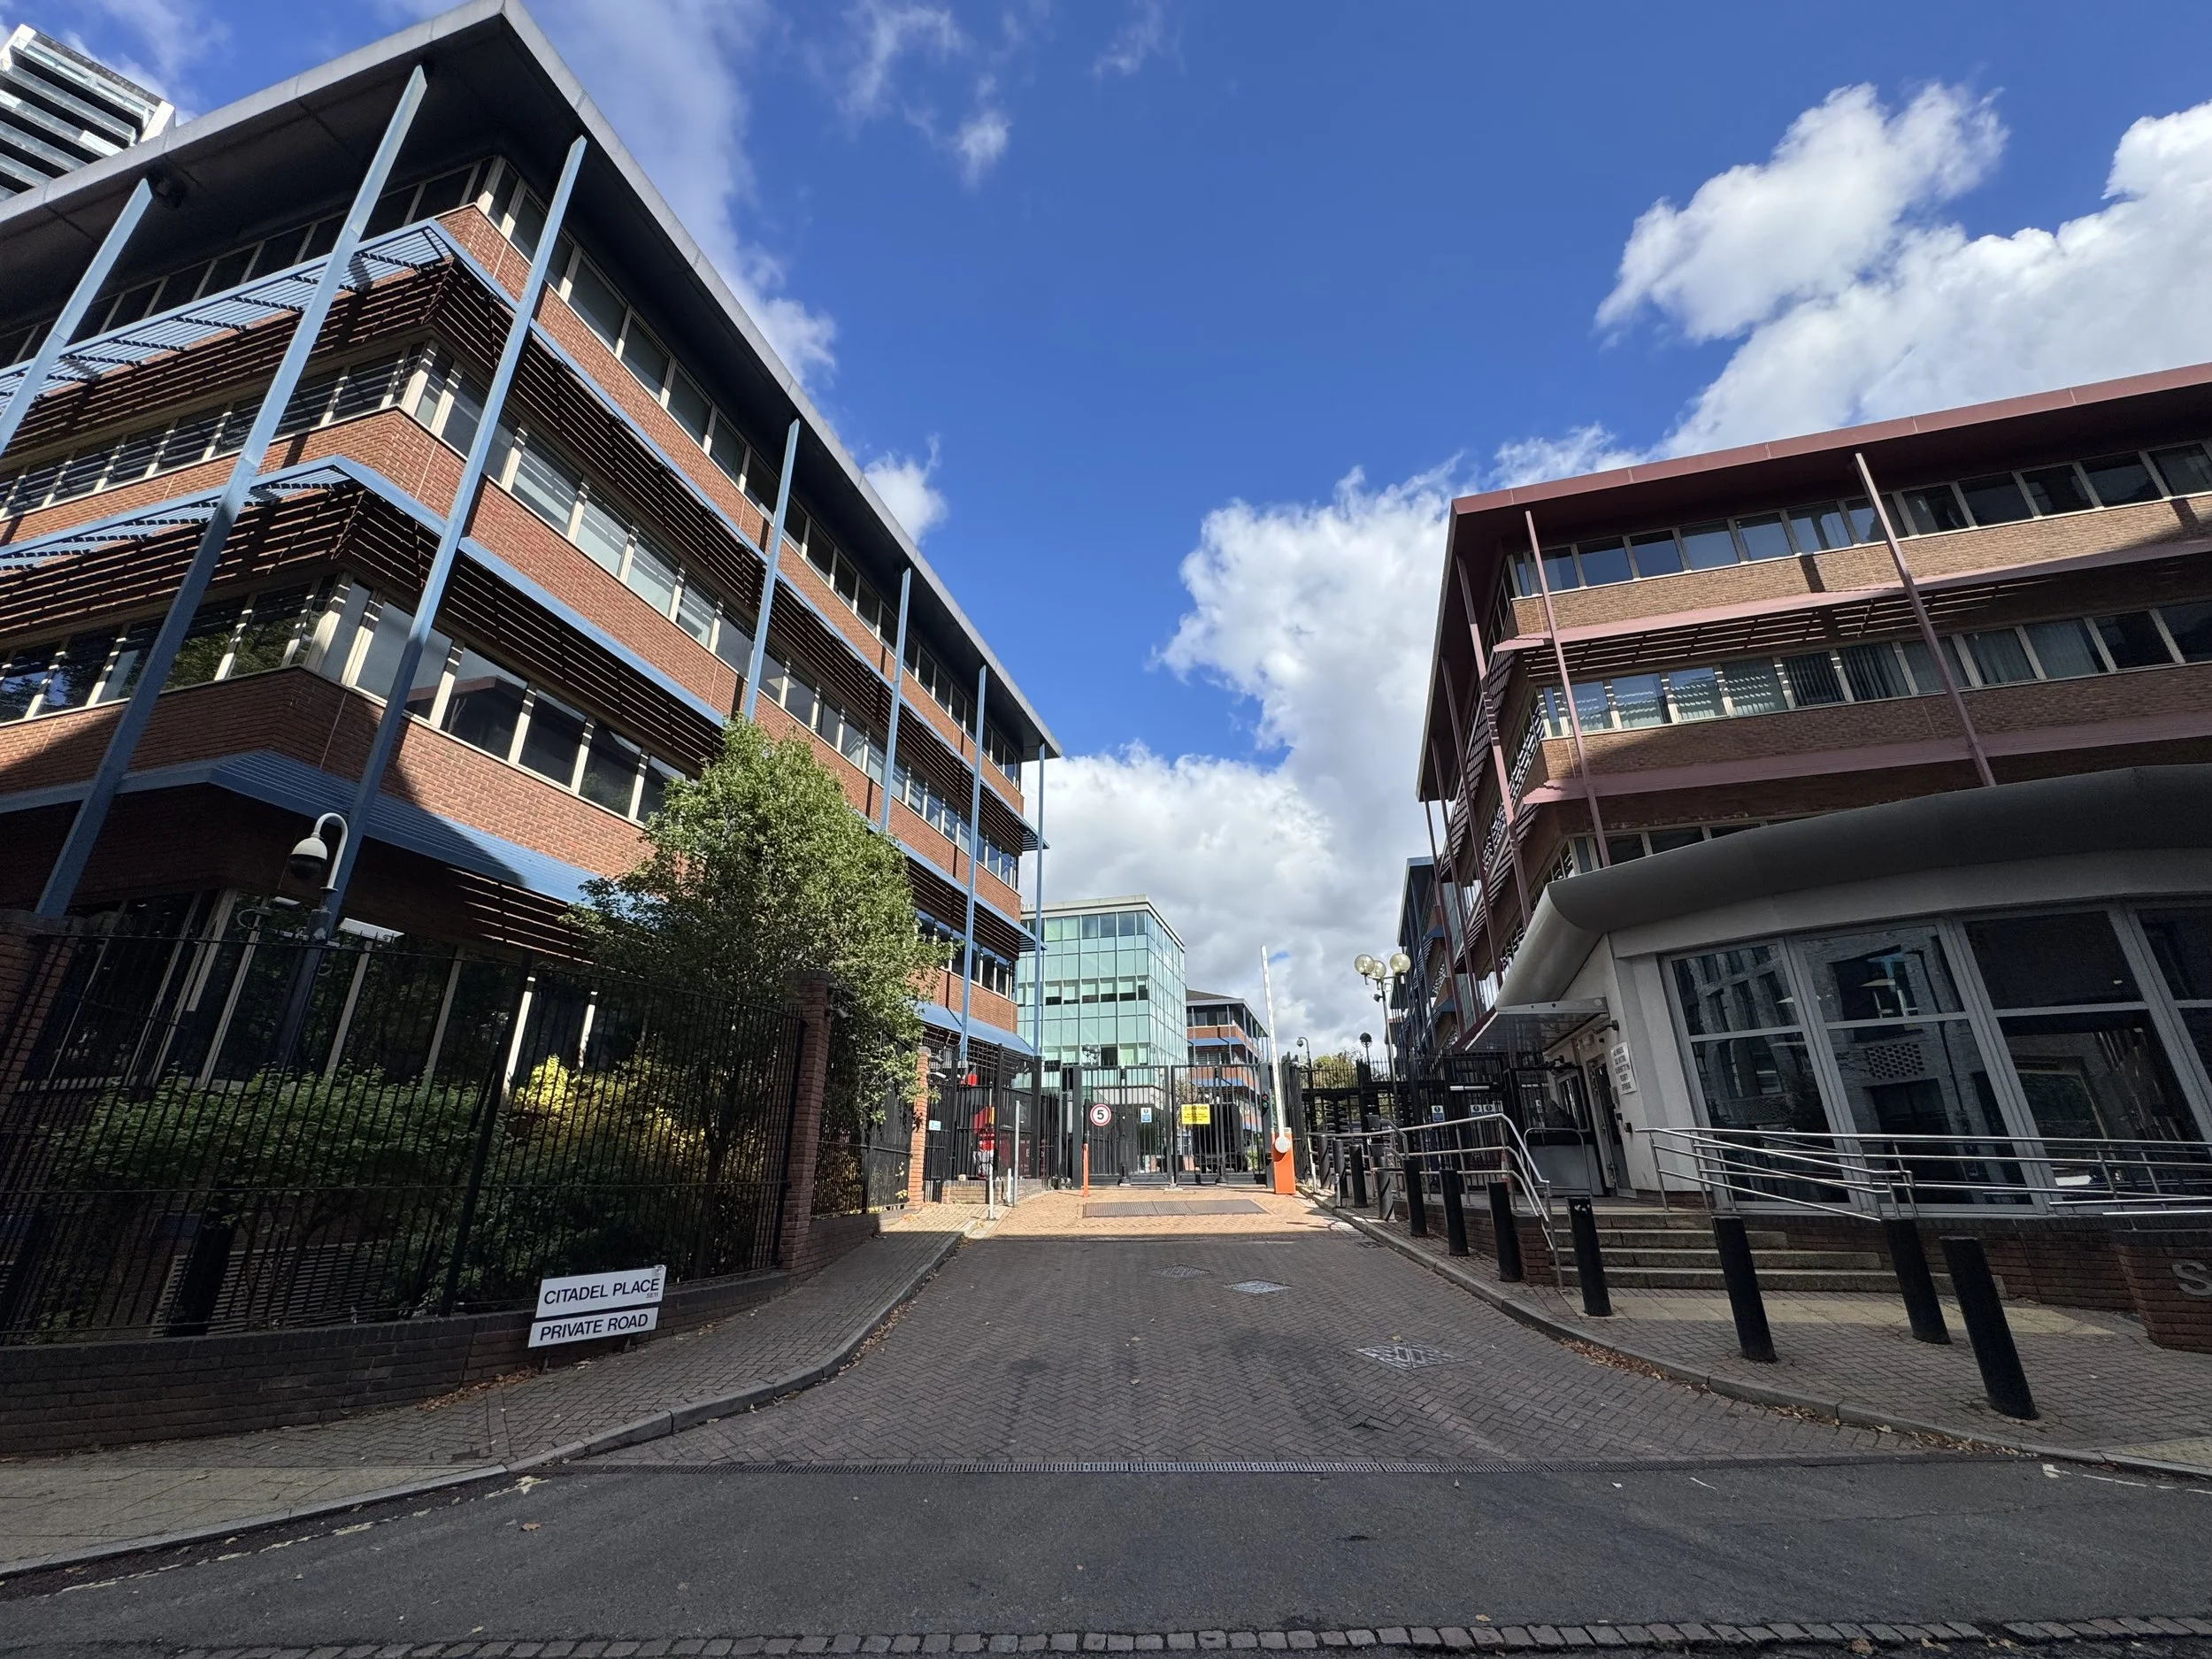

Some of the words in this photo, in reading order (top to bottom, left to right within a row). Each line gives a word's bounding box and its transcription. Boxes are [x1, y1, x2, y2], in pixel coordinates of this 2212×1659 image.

[1097, 1110, 1104, 1120] 5
[544, 1285, 608, 1305] CITADEL
[612, 1279, 660, 1296] PLACE
[540, 1319, 603, 1340] PRIVATE
[607, 1314, 648, 1331] ROAD
